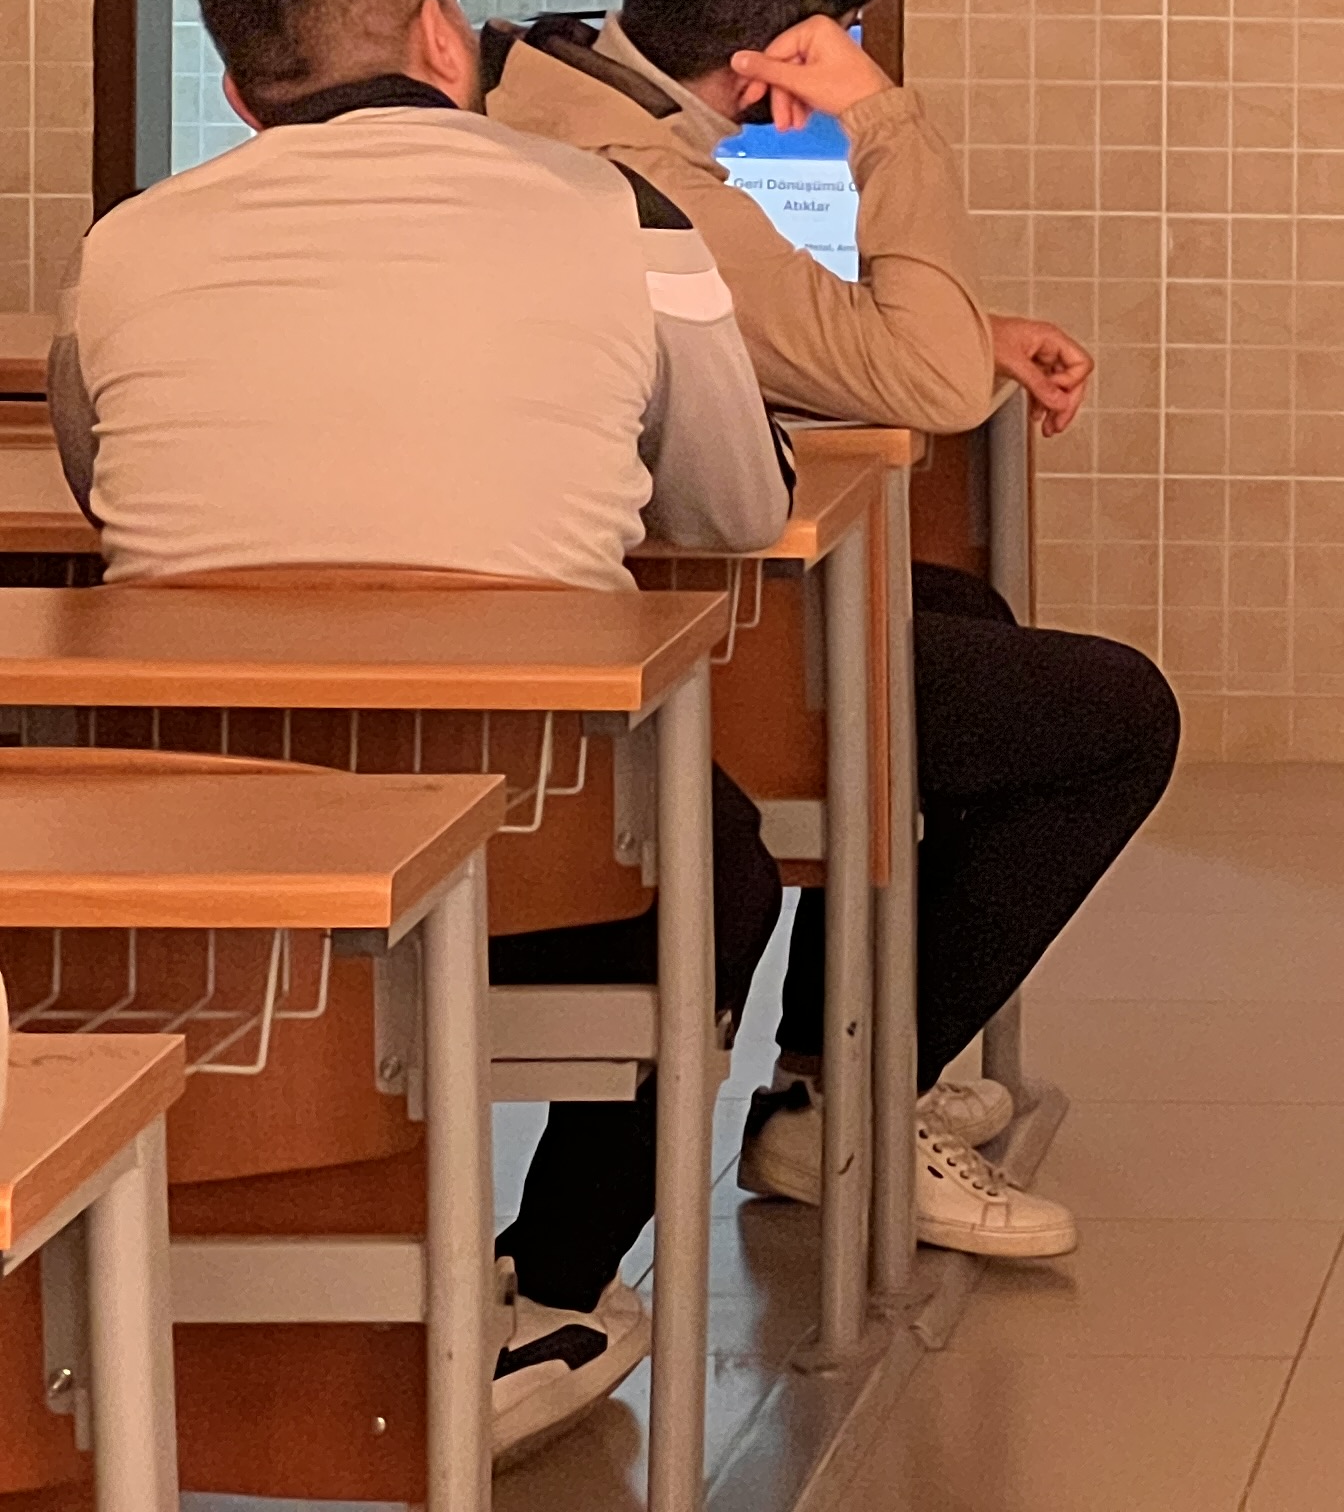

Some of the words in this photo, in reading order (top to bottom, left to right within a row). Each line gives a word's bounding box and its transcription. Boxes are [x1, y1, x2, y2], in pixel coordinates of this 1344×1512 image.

[733, 178, 763, 190] Geri
[766, 178, 845, 192] Dönüşümü
[783, 199, 831, 212] Atıklar
